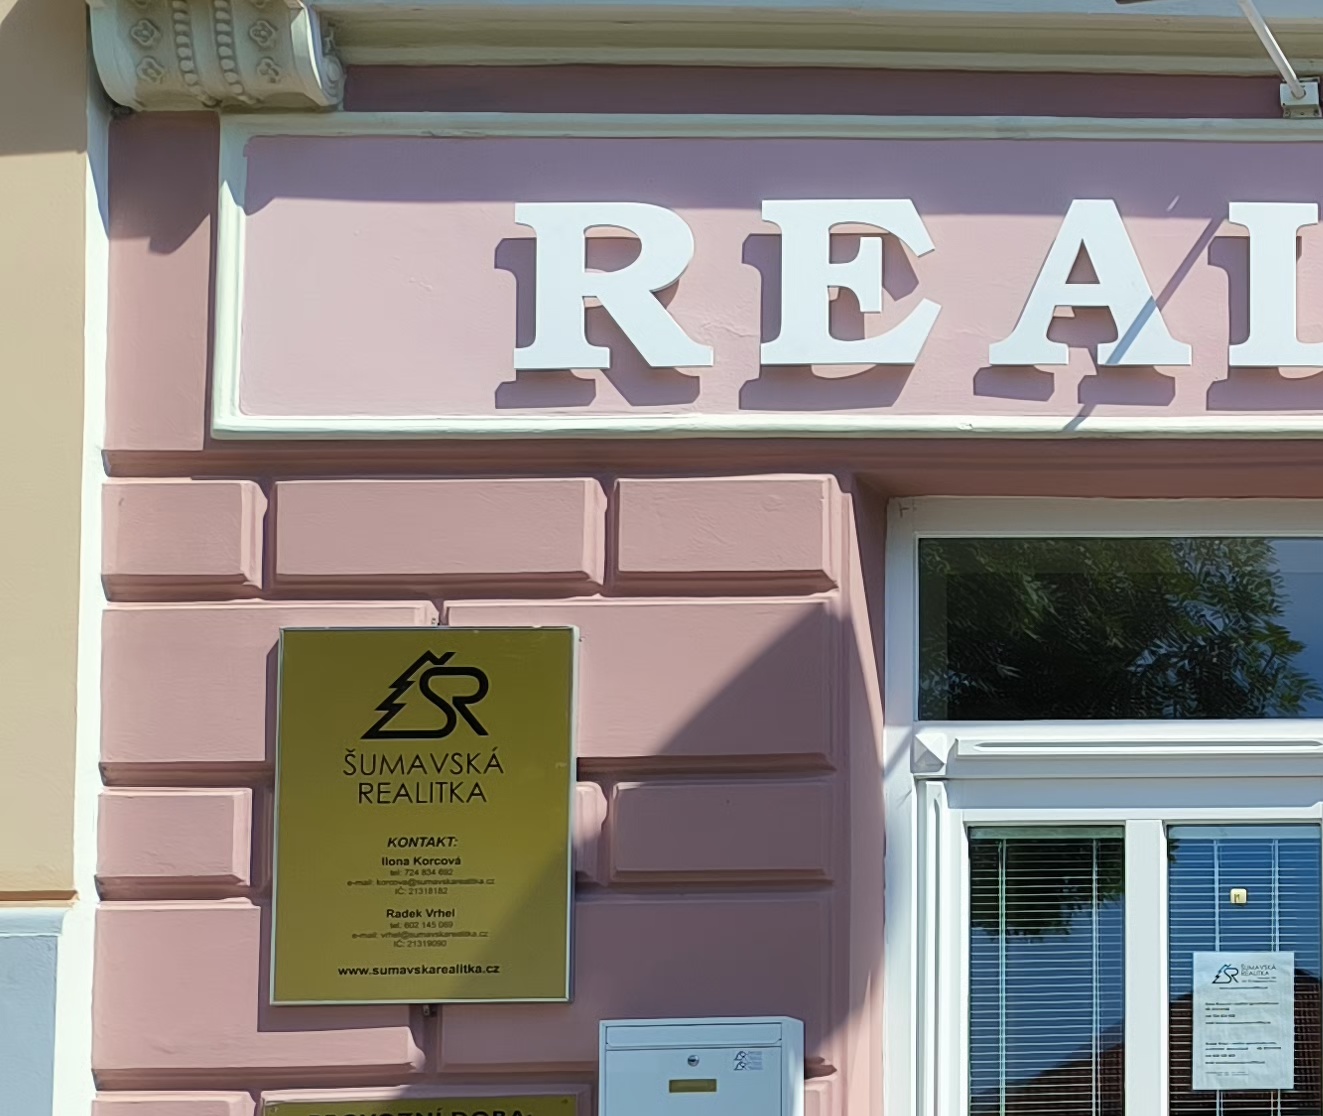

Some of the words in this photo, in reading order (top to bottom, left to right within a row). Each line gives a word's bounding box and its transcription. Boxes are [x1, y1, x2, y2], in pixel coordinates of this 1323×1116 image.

[343, 746, 504, 776] ŠUMAVSKÁ
[358, 781, 487, 804] REALITKA
[387, 836, 458, 848] KONTAKT:
[381, 857, 410, 866] Ilona
[413, 856, 461, 866] Korcová
[386, 909, 422, 918] Radek
[425, 908, 455, 918] Vrhel
[338, 964, 500, 976] www.sumavskarealitka.cz
